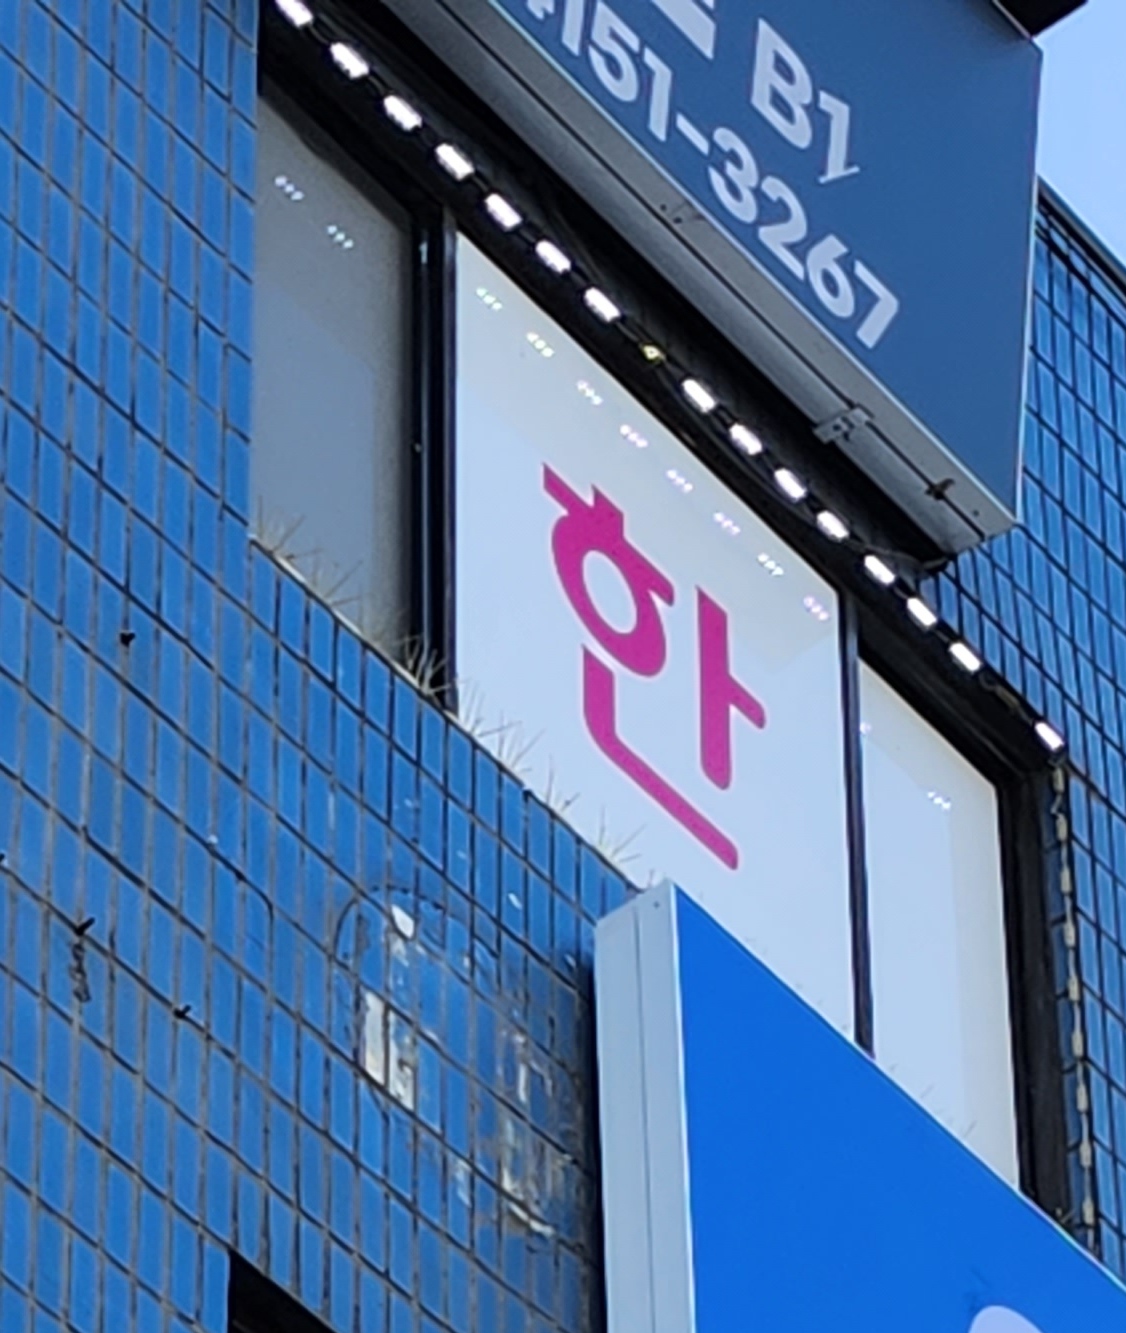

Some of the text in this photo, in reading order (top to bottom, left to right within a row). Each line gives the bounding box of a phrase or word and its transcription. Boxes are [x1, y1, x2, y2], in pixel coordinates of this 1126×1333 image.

[526, 0, 899, 349] 151-3267
[751, 18, 860, 184] B1
[543, 462, 766, 870] 한
